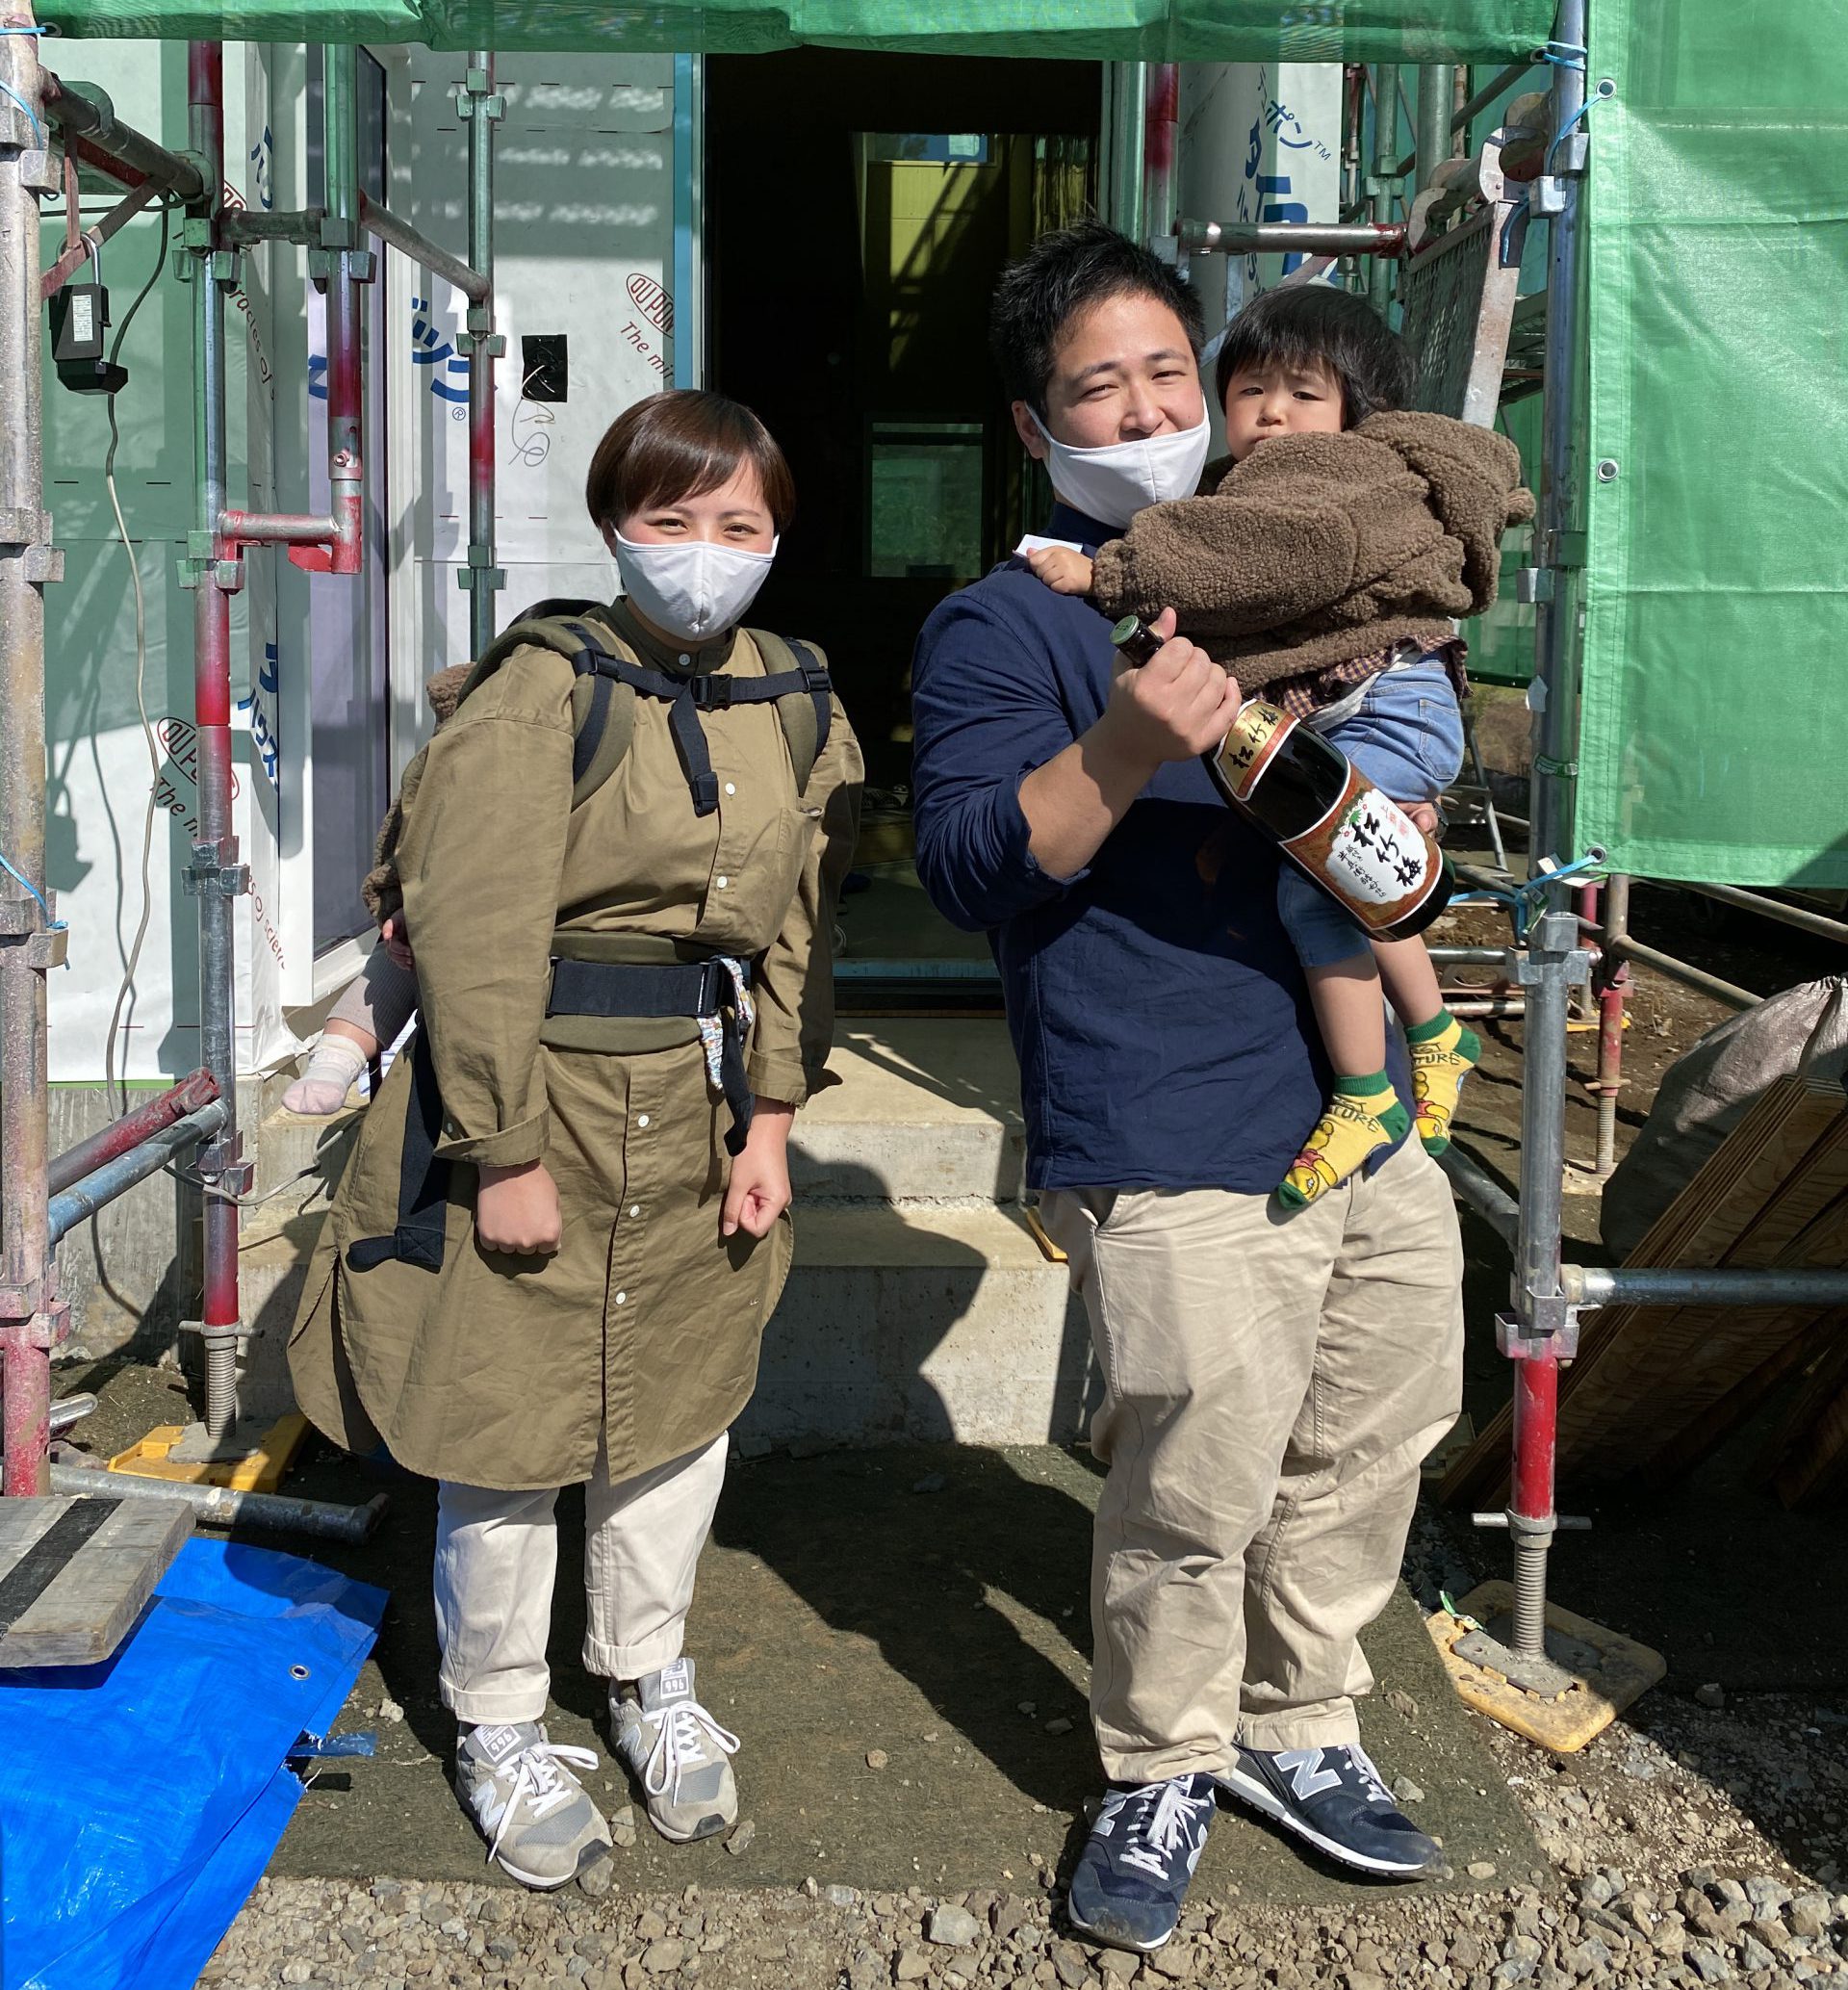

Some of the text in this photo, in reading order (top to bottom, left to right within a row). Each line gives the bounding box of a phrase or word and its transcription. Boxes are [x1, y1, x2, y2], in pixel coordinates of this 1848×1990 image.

[229, 288, 262, 353] racles
[620, 321, 674, 386] The mir
[1228, 707, 1279, 769] 松竹梅
[1351, 812, 1423, 888] 松竹梅
[664, 1678, 684, 1693] 996
[490, 1732, 513, 1752] 996
